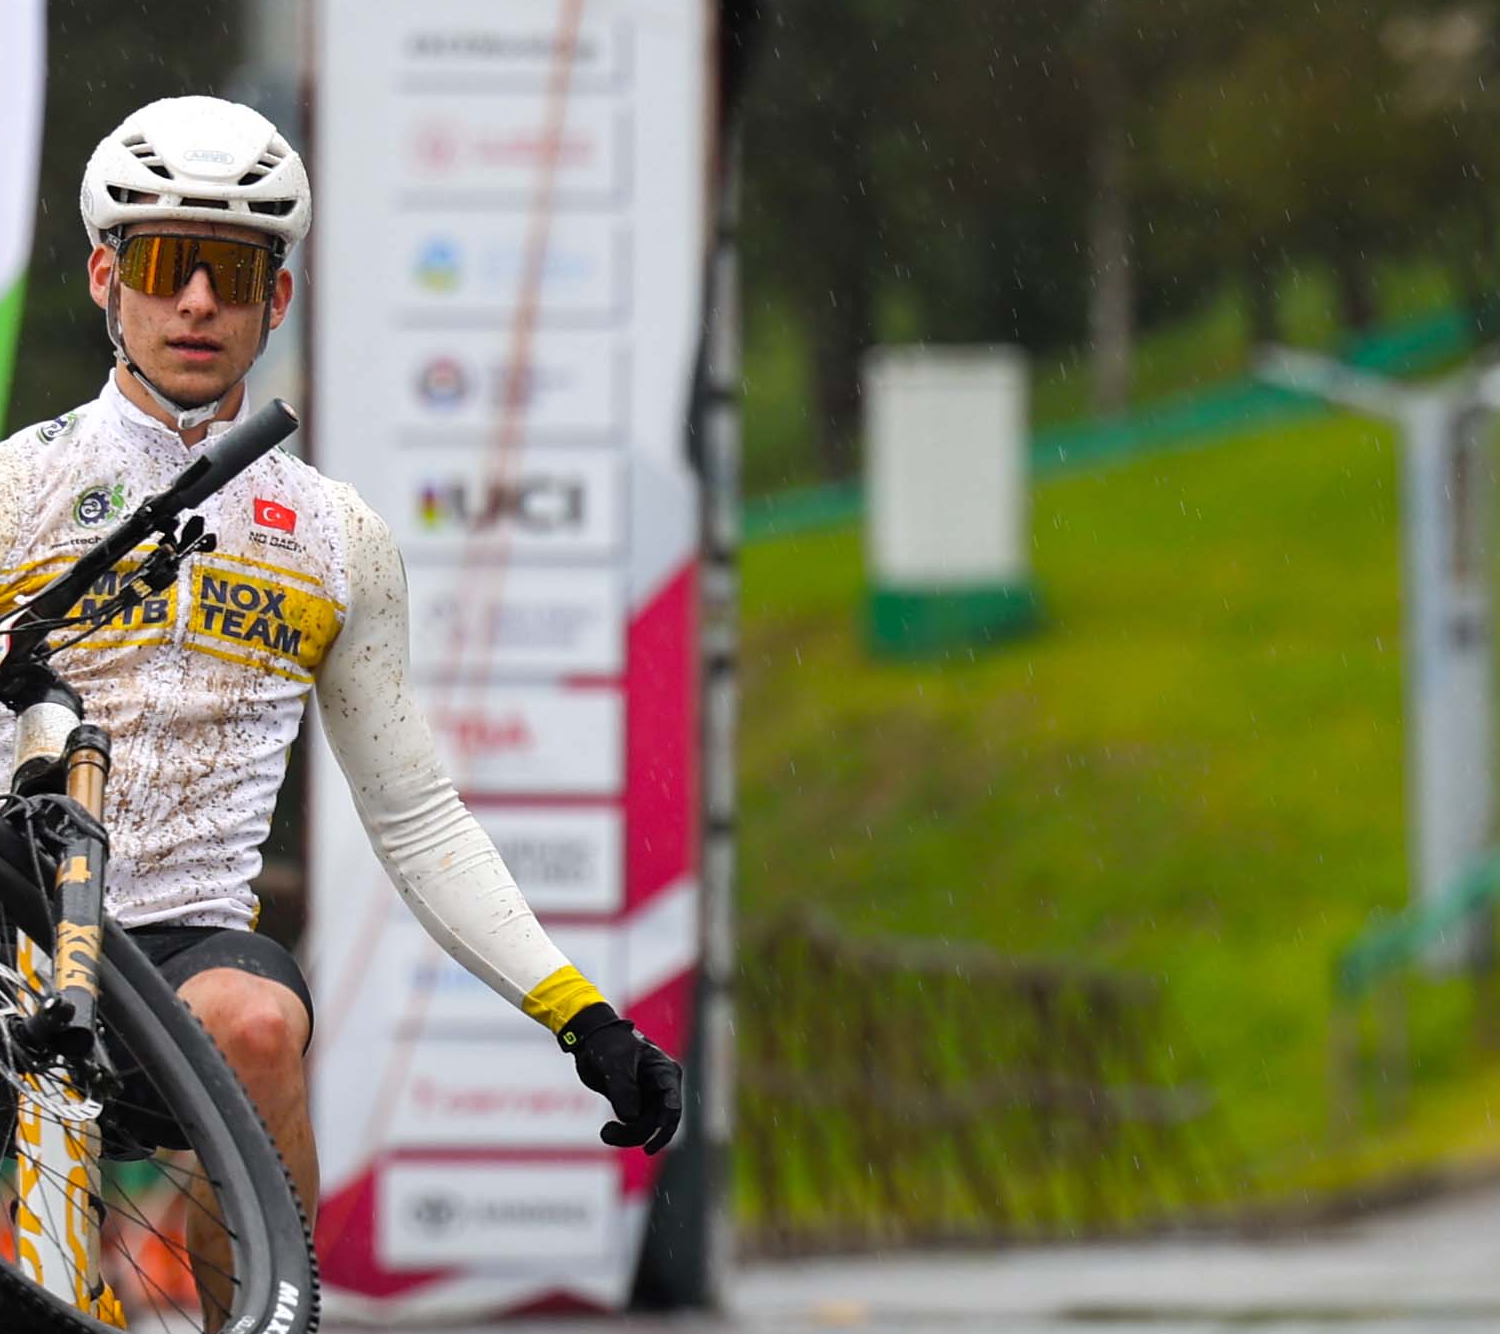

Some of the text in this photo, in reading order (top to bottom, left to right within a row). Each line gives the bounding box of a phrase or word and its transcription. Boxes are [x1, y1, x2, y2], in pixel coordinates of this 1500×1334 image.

[448, 479, 583, 530] UCI
[201, 575, 286, 619] NOX
[200, 603, 302, 656] TEAM
